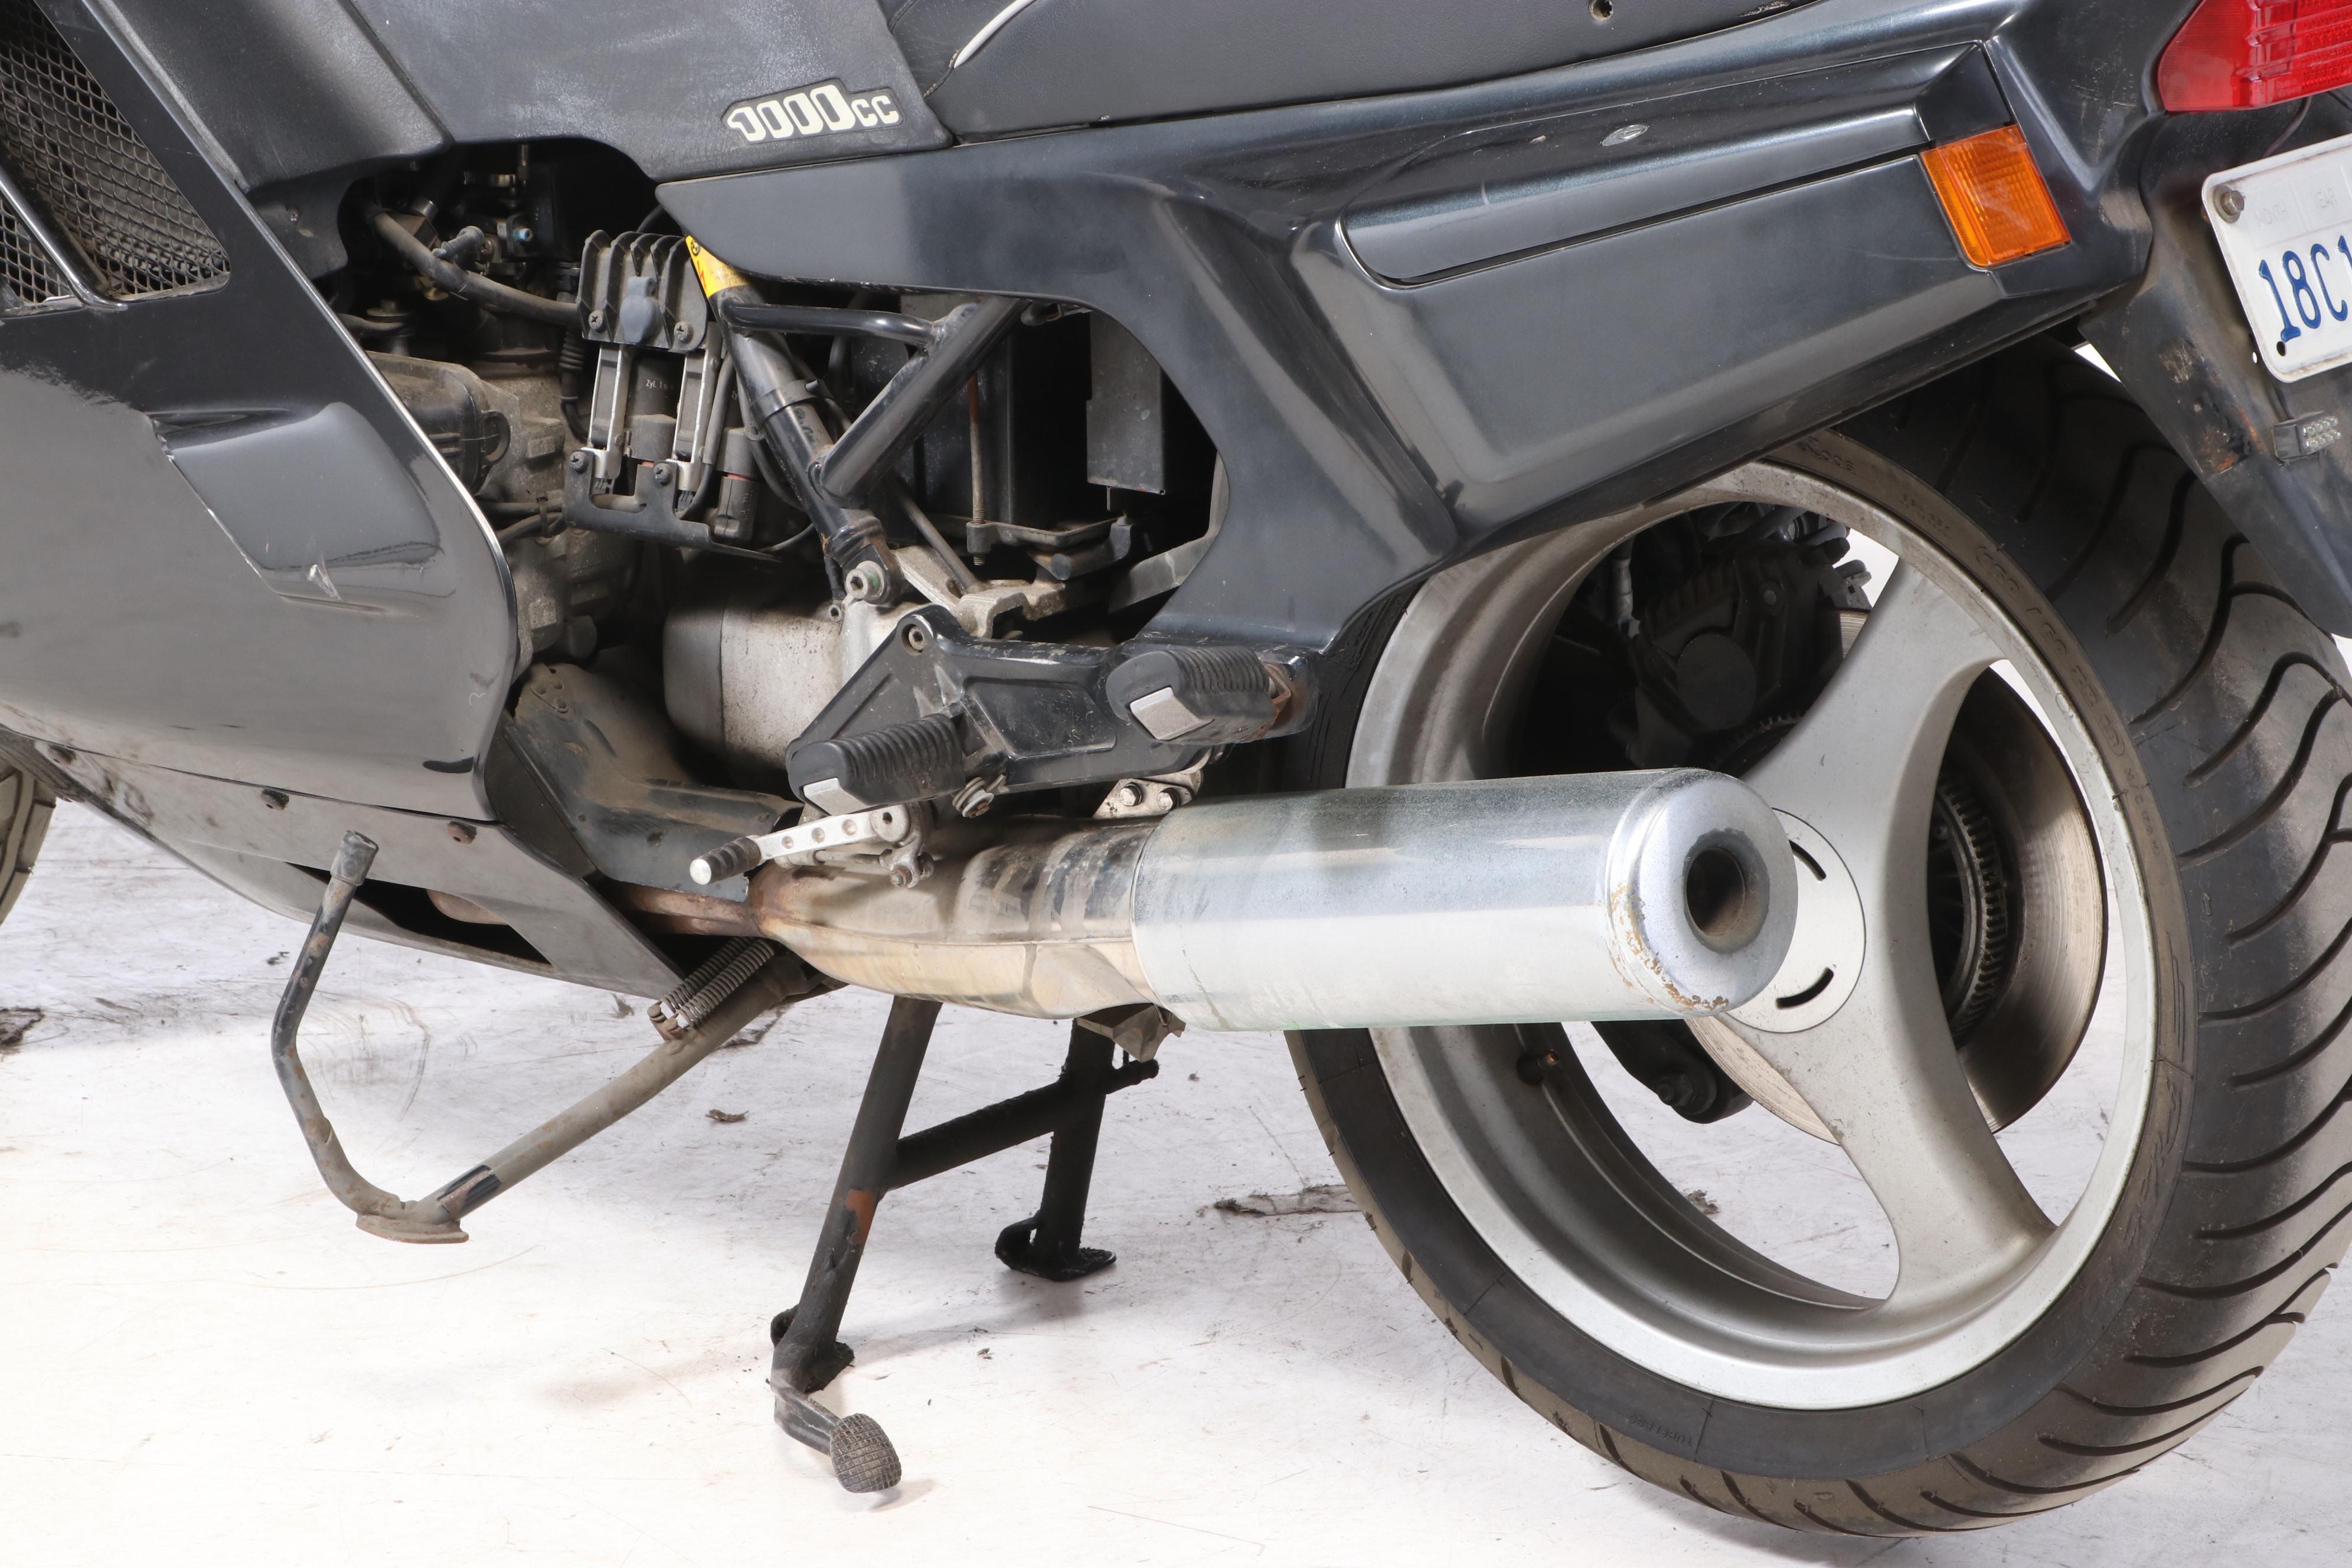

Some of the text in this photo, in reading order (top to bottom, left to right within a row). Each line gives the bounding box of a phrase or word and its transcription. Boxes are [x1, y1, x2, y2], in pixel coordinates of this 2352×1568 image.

[727, 84, 899, 142] 1000cc
[2254, 187, 2339, 228] MONTH YEAR
[1628, 1416, 1693, 1447] TUBELESS
